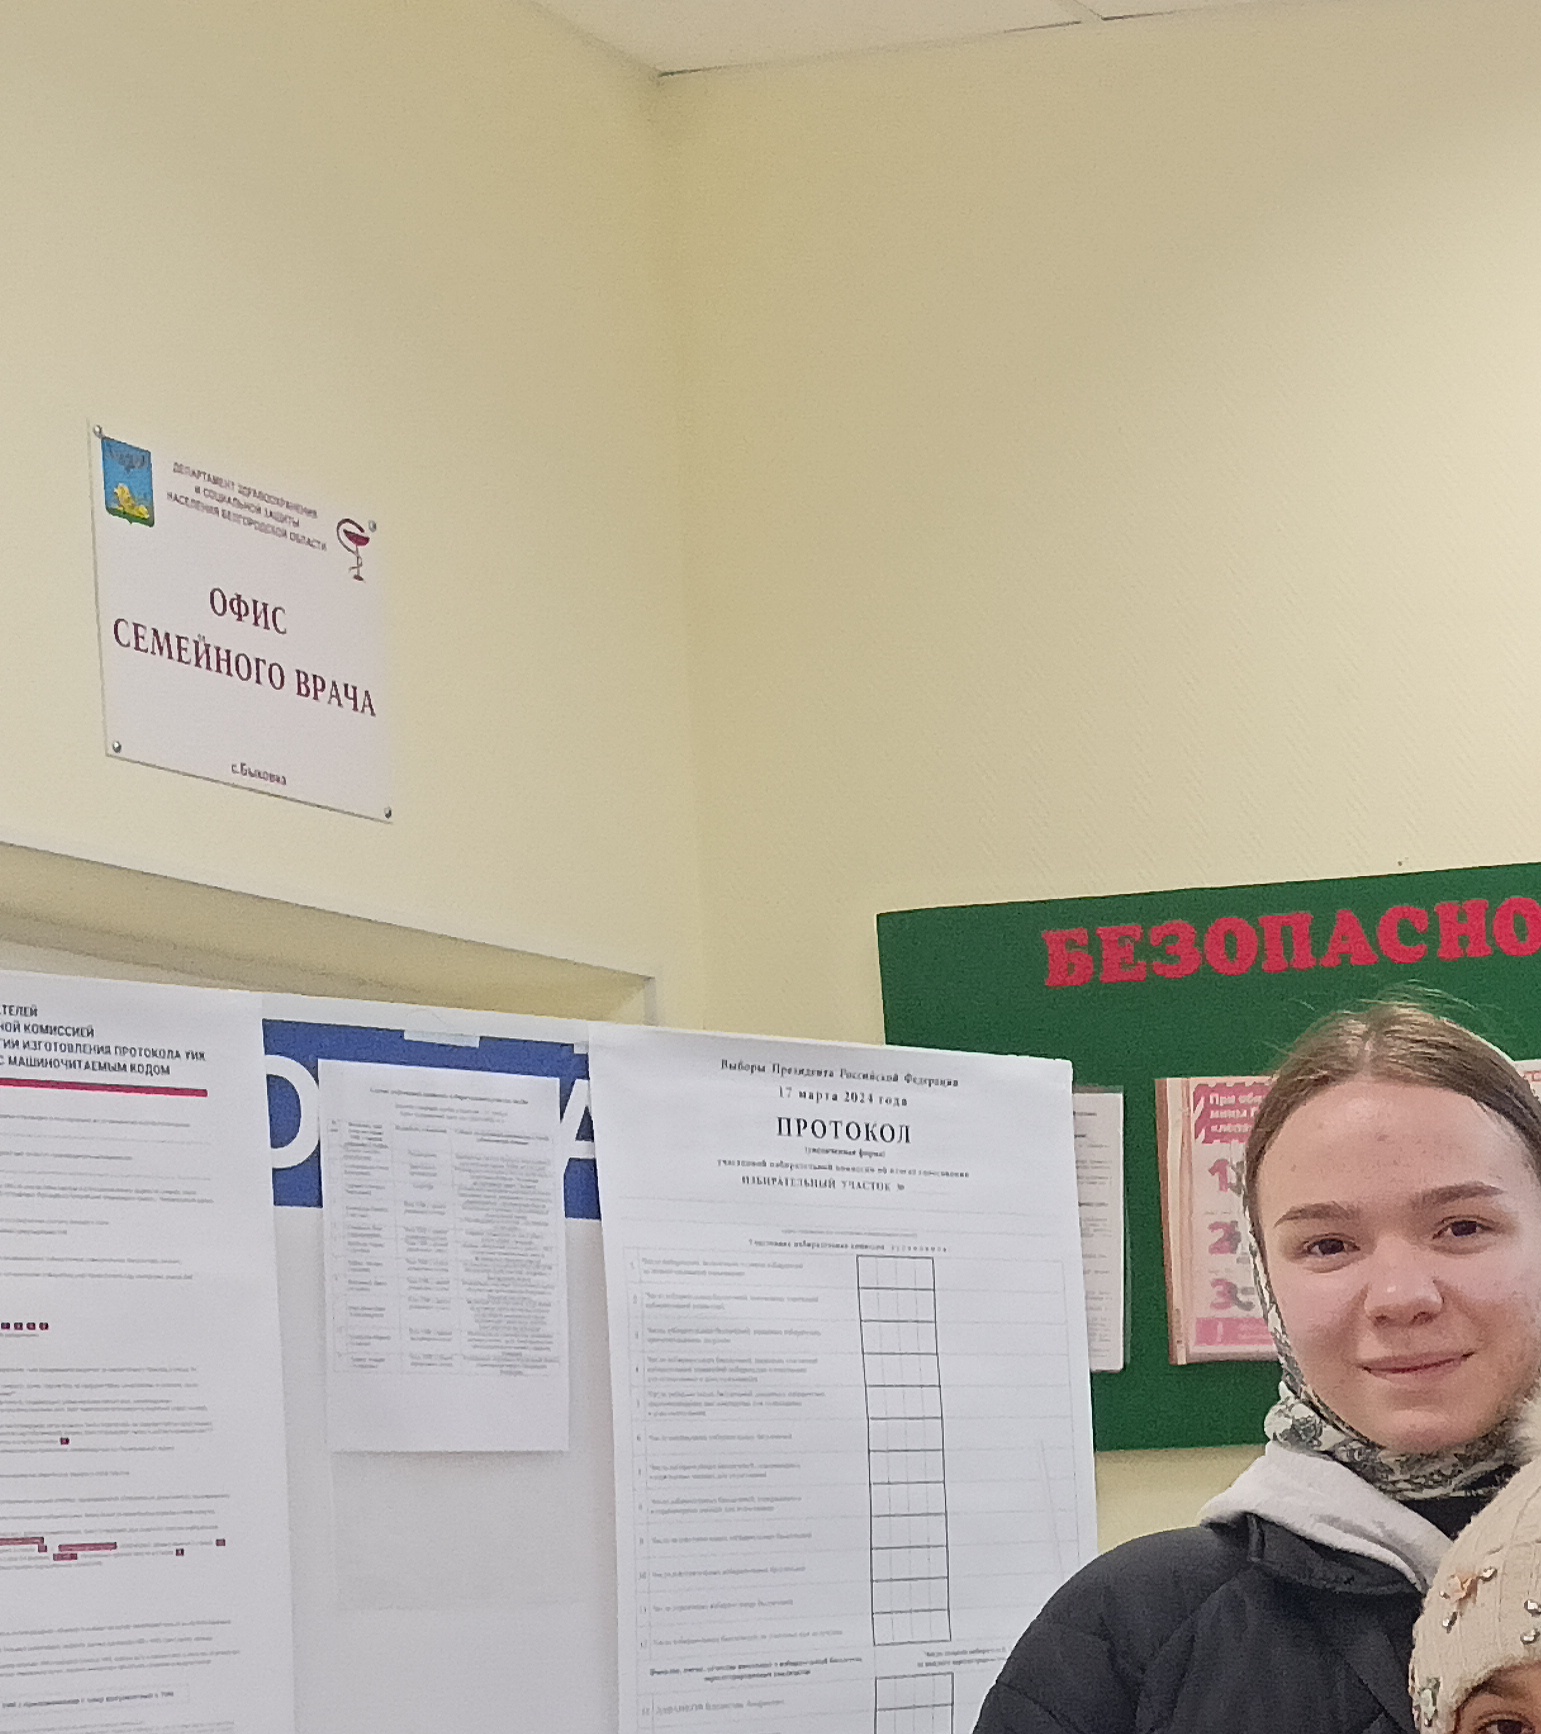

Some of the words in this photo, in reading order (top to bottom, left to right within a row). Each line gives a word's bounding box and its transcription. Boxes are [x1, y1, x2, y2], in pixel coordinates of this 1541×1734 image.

[209, 586, 288, 636] ОФИС
[112, 617, 286, 691] СЕМЕЙНОГО
[294, 668, 376, 718] ВРАЧА
[0, 1004, 38, 1017] ТЕЛЕЙ
[23, 1022, 95, 1038] КОМИССИЕЙ
[22, 1038, 111, 1056] ИЗГОТОВЛЕНИЯ
[114, 1045, 182, 1060] ПРОТОКОЛА
[130, 1063, 171, 1077] КОДОМ
[778, 1085, 792, 1098] 17
[776, 1115, 911, 1145] ПРОТОКОЛ
